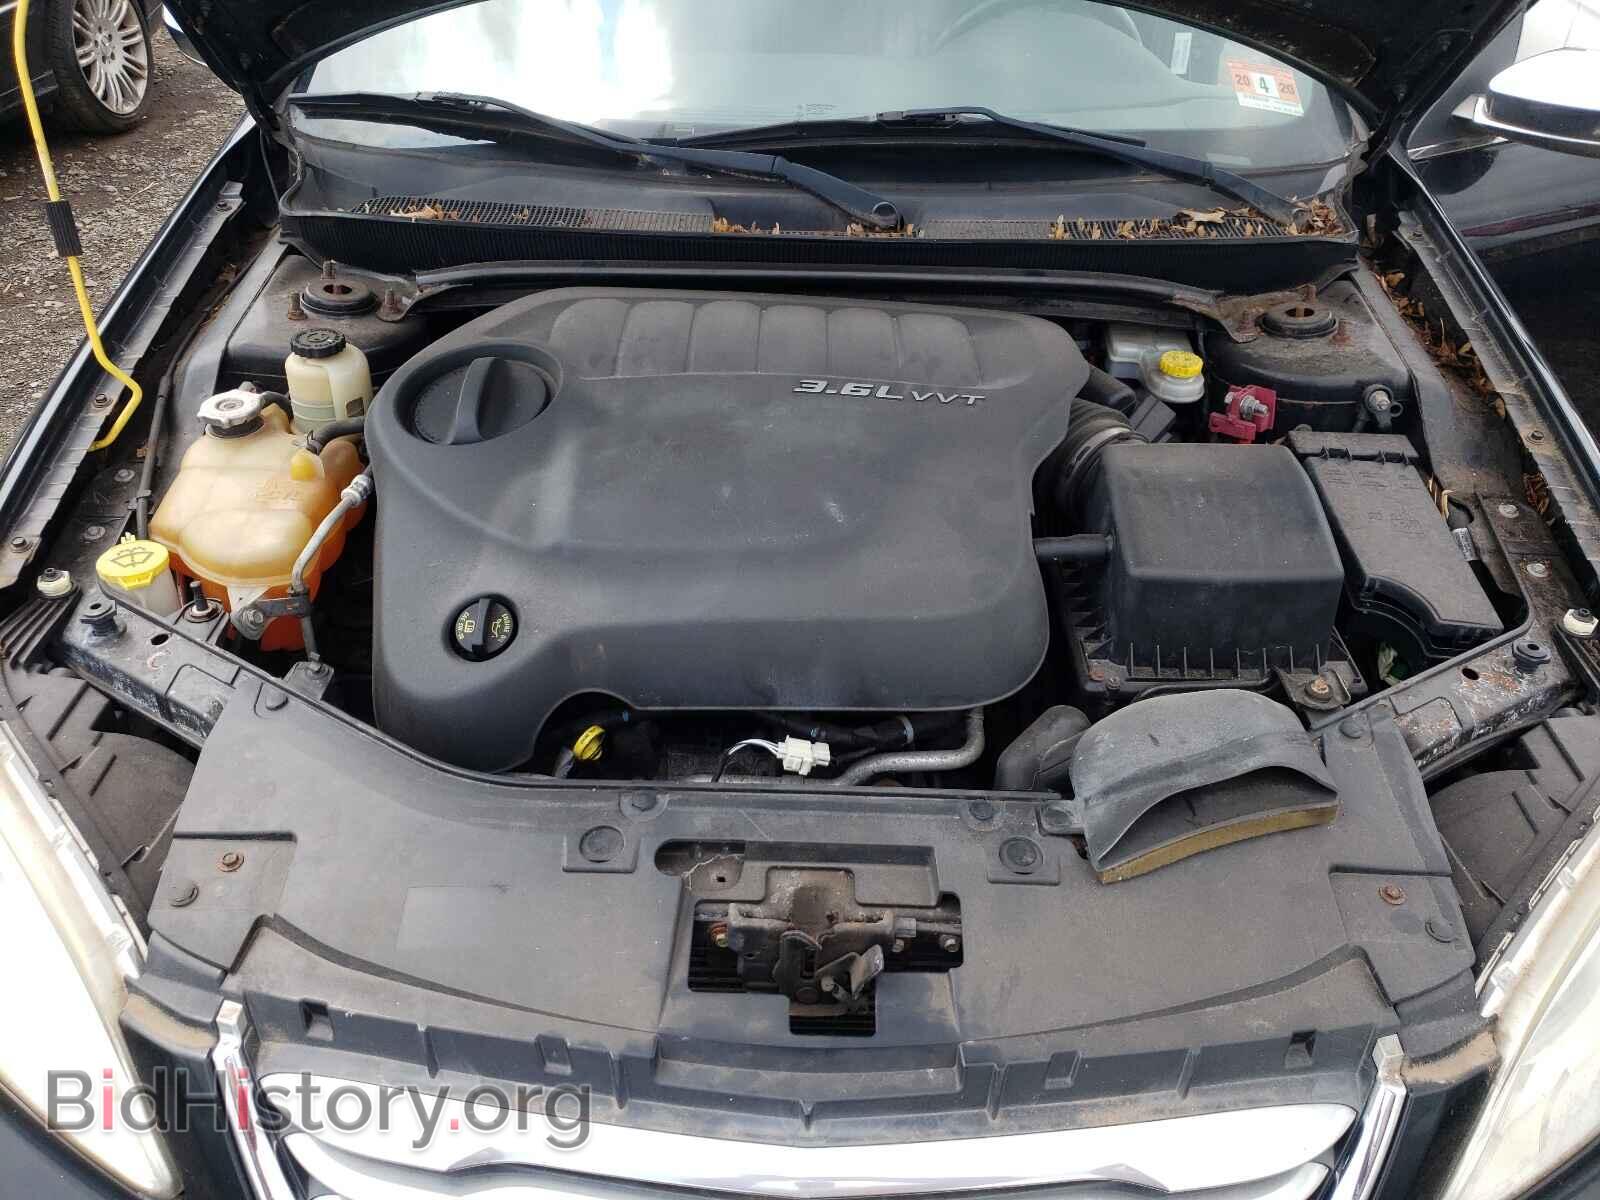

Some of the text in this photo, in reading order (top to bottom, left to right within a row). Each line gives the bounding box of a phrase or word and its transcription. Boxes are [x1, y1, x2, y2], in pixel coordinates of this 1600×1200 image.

[1234, 73, 1250, 88] 20
[1259, 76, 1270, 93] 4
[792, 379, 986, 406] 3.6L VVT
